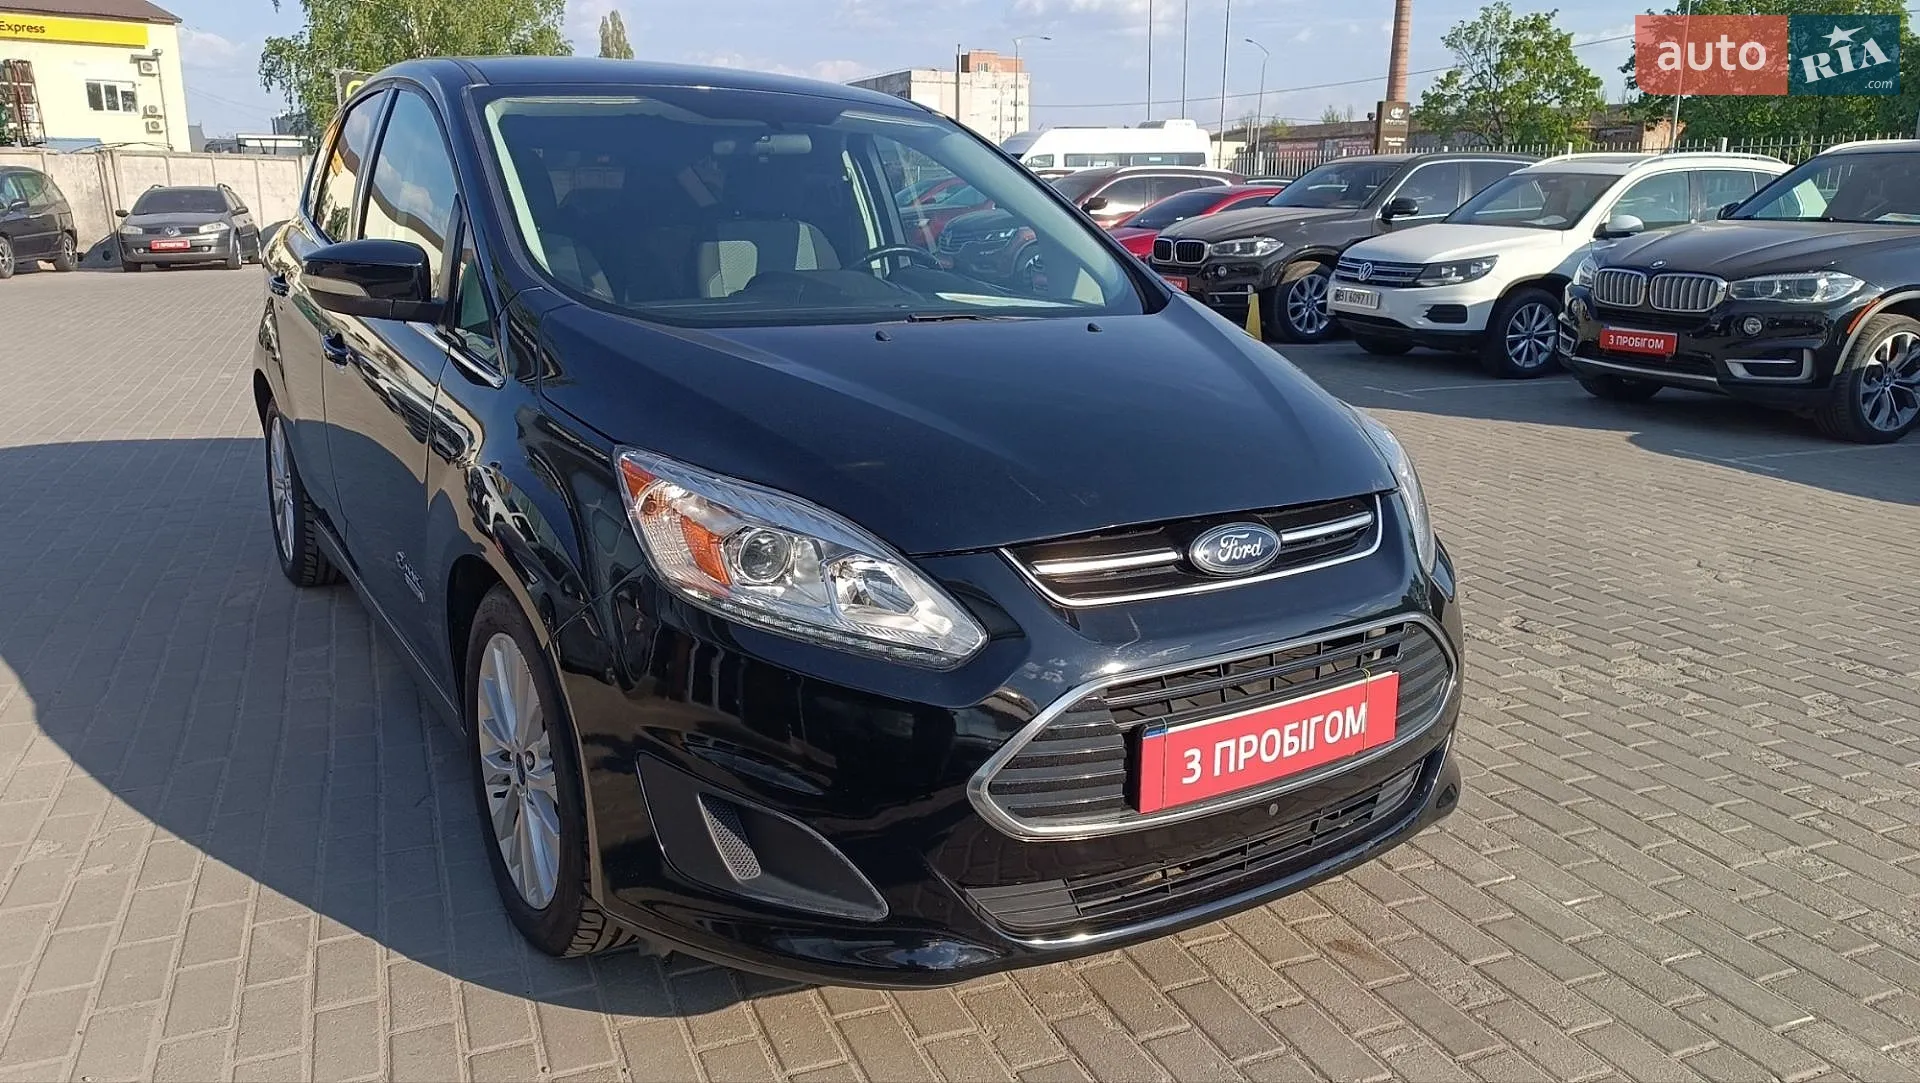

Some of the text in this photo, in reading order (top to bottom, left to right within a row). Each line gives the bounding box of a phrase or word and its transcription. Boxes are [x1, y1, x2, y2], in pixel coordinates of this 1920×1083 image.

[1616, 335, 1664, 350] ПРОБІГОМ
[1217, 533, 1262, 563] Ford
[1212, 701, 1367, 777] ПРОБІГОМ
